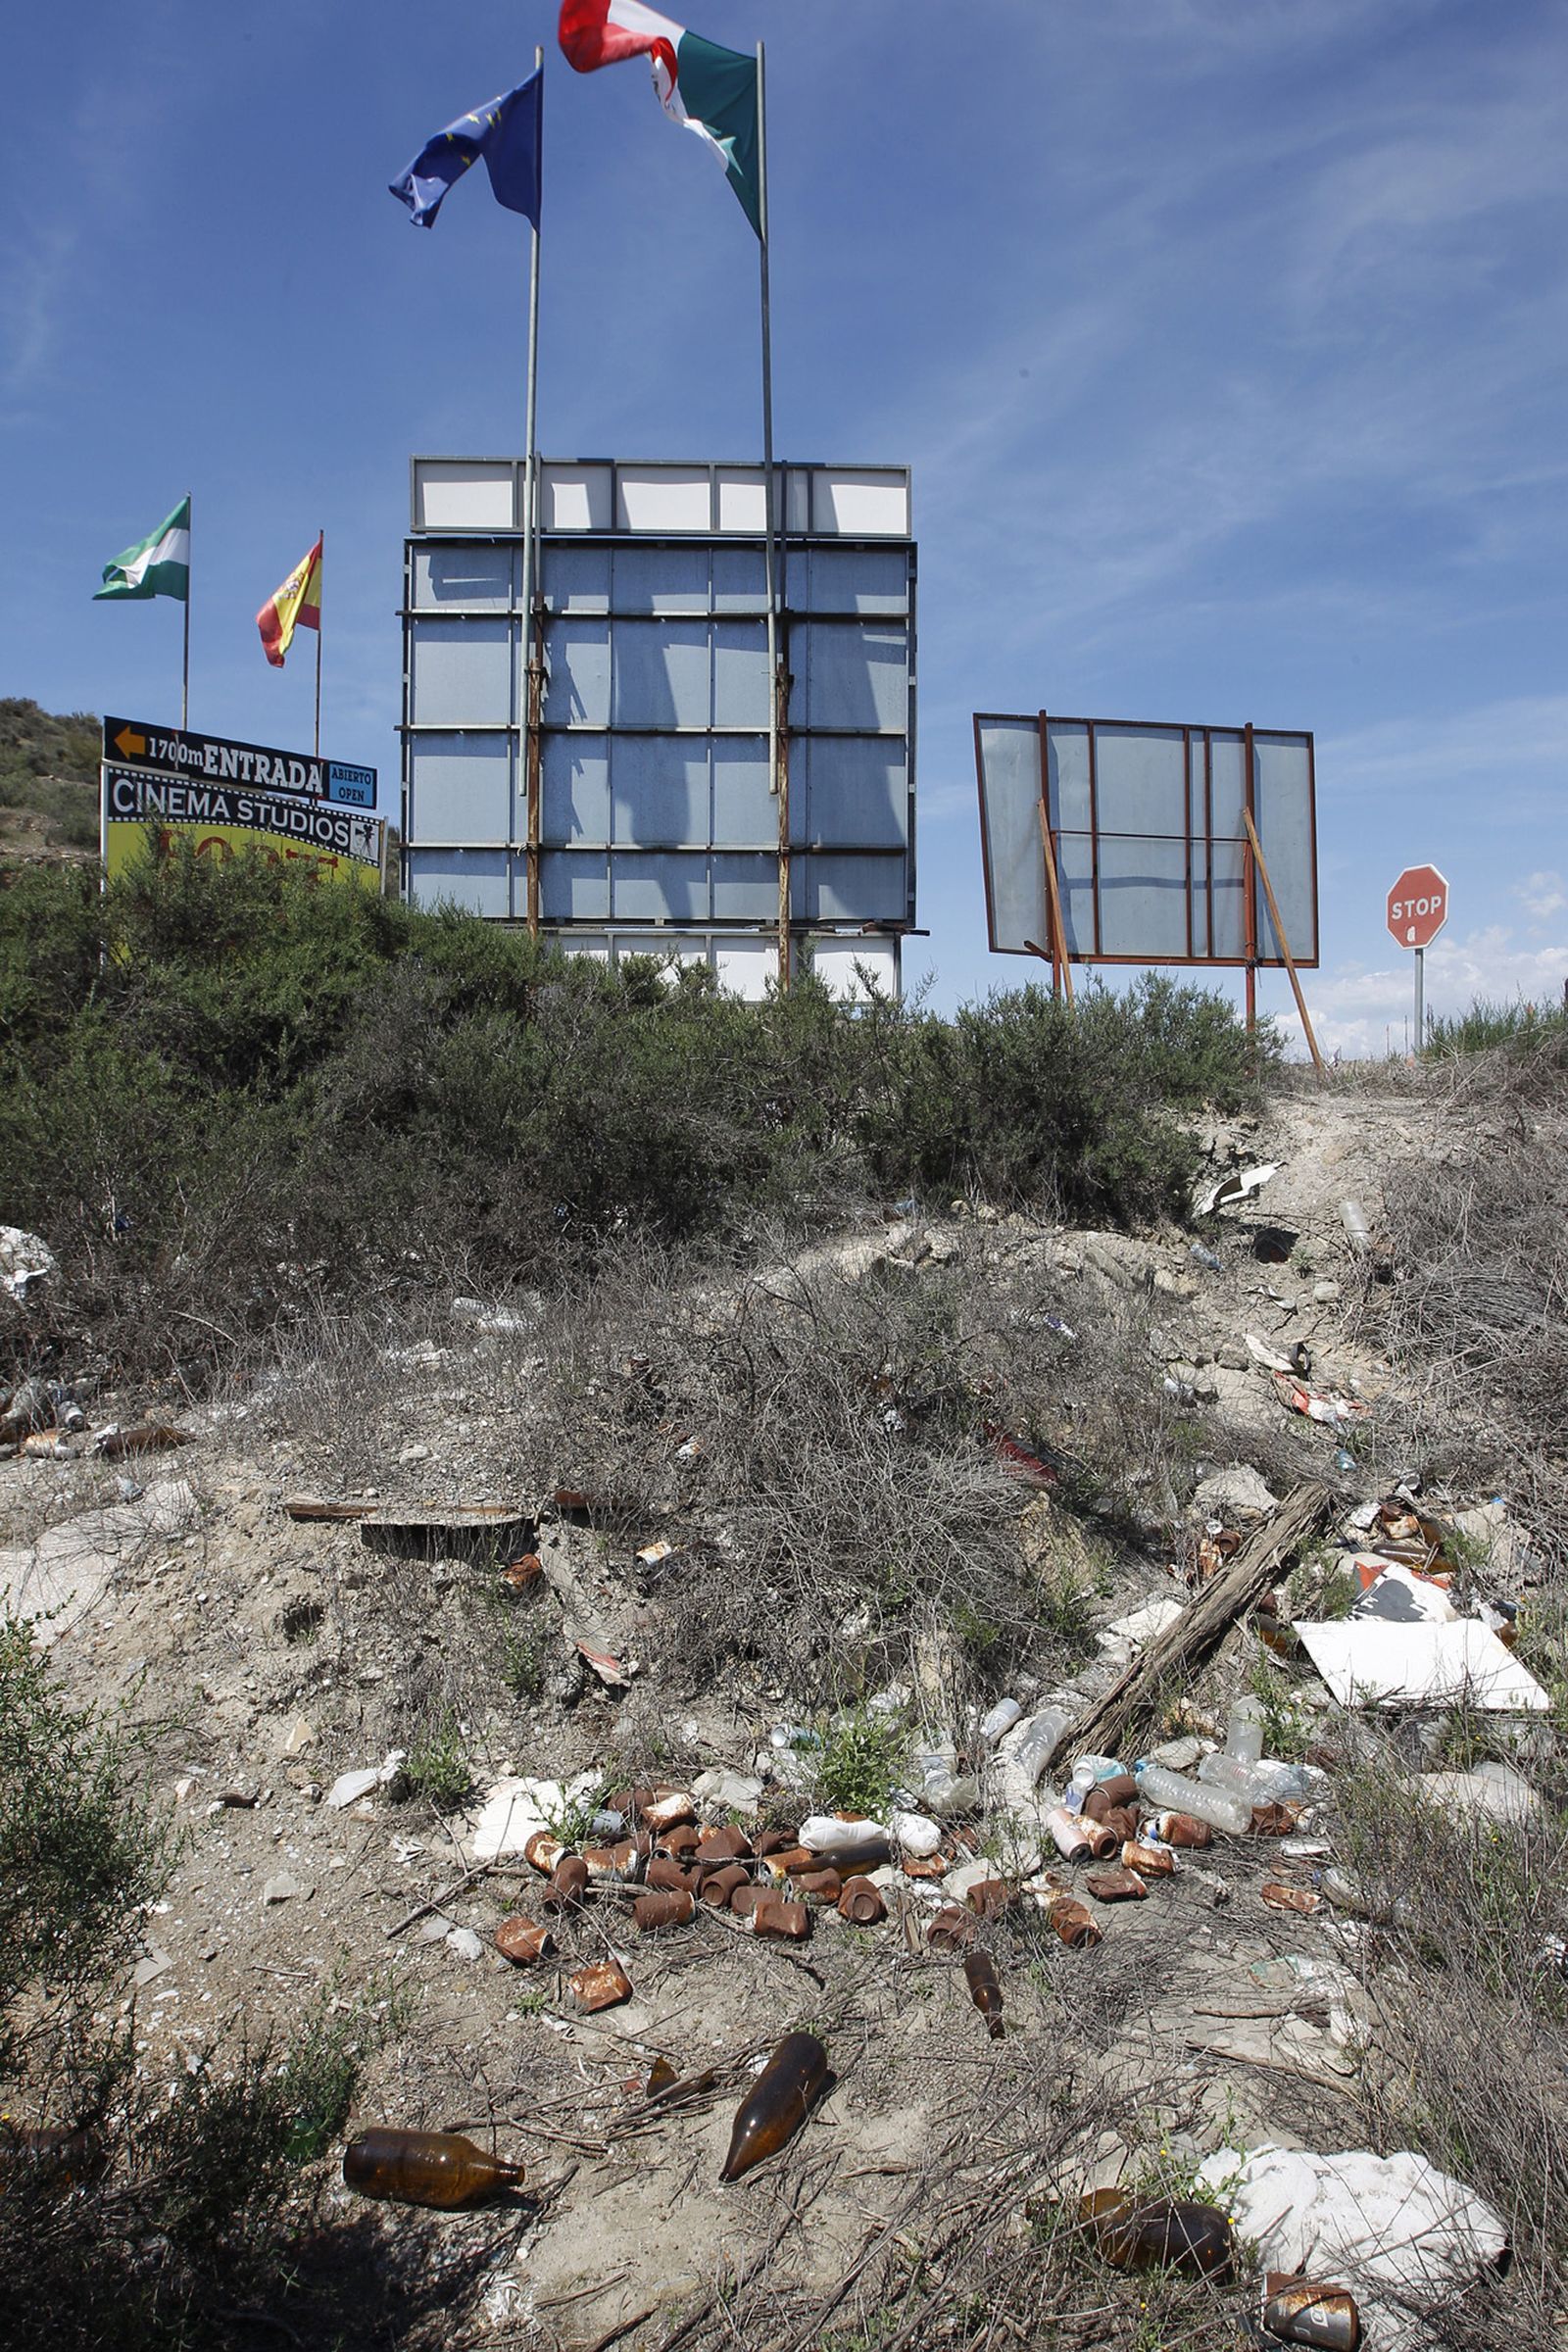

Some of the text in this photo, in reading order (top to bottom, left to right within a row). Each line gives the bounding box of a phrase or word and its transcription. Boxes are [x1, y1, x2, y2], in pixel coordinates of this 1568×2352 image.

[203, 743, 323, 794] ENTRADA
[331, 766, 371, 785] ABIERTO
[338, 787, 365, 803] OPEN
[113, 778, 349, 848] CINEMA STUDIOS
[1392, 895, 1442, 919] STOP
